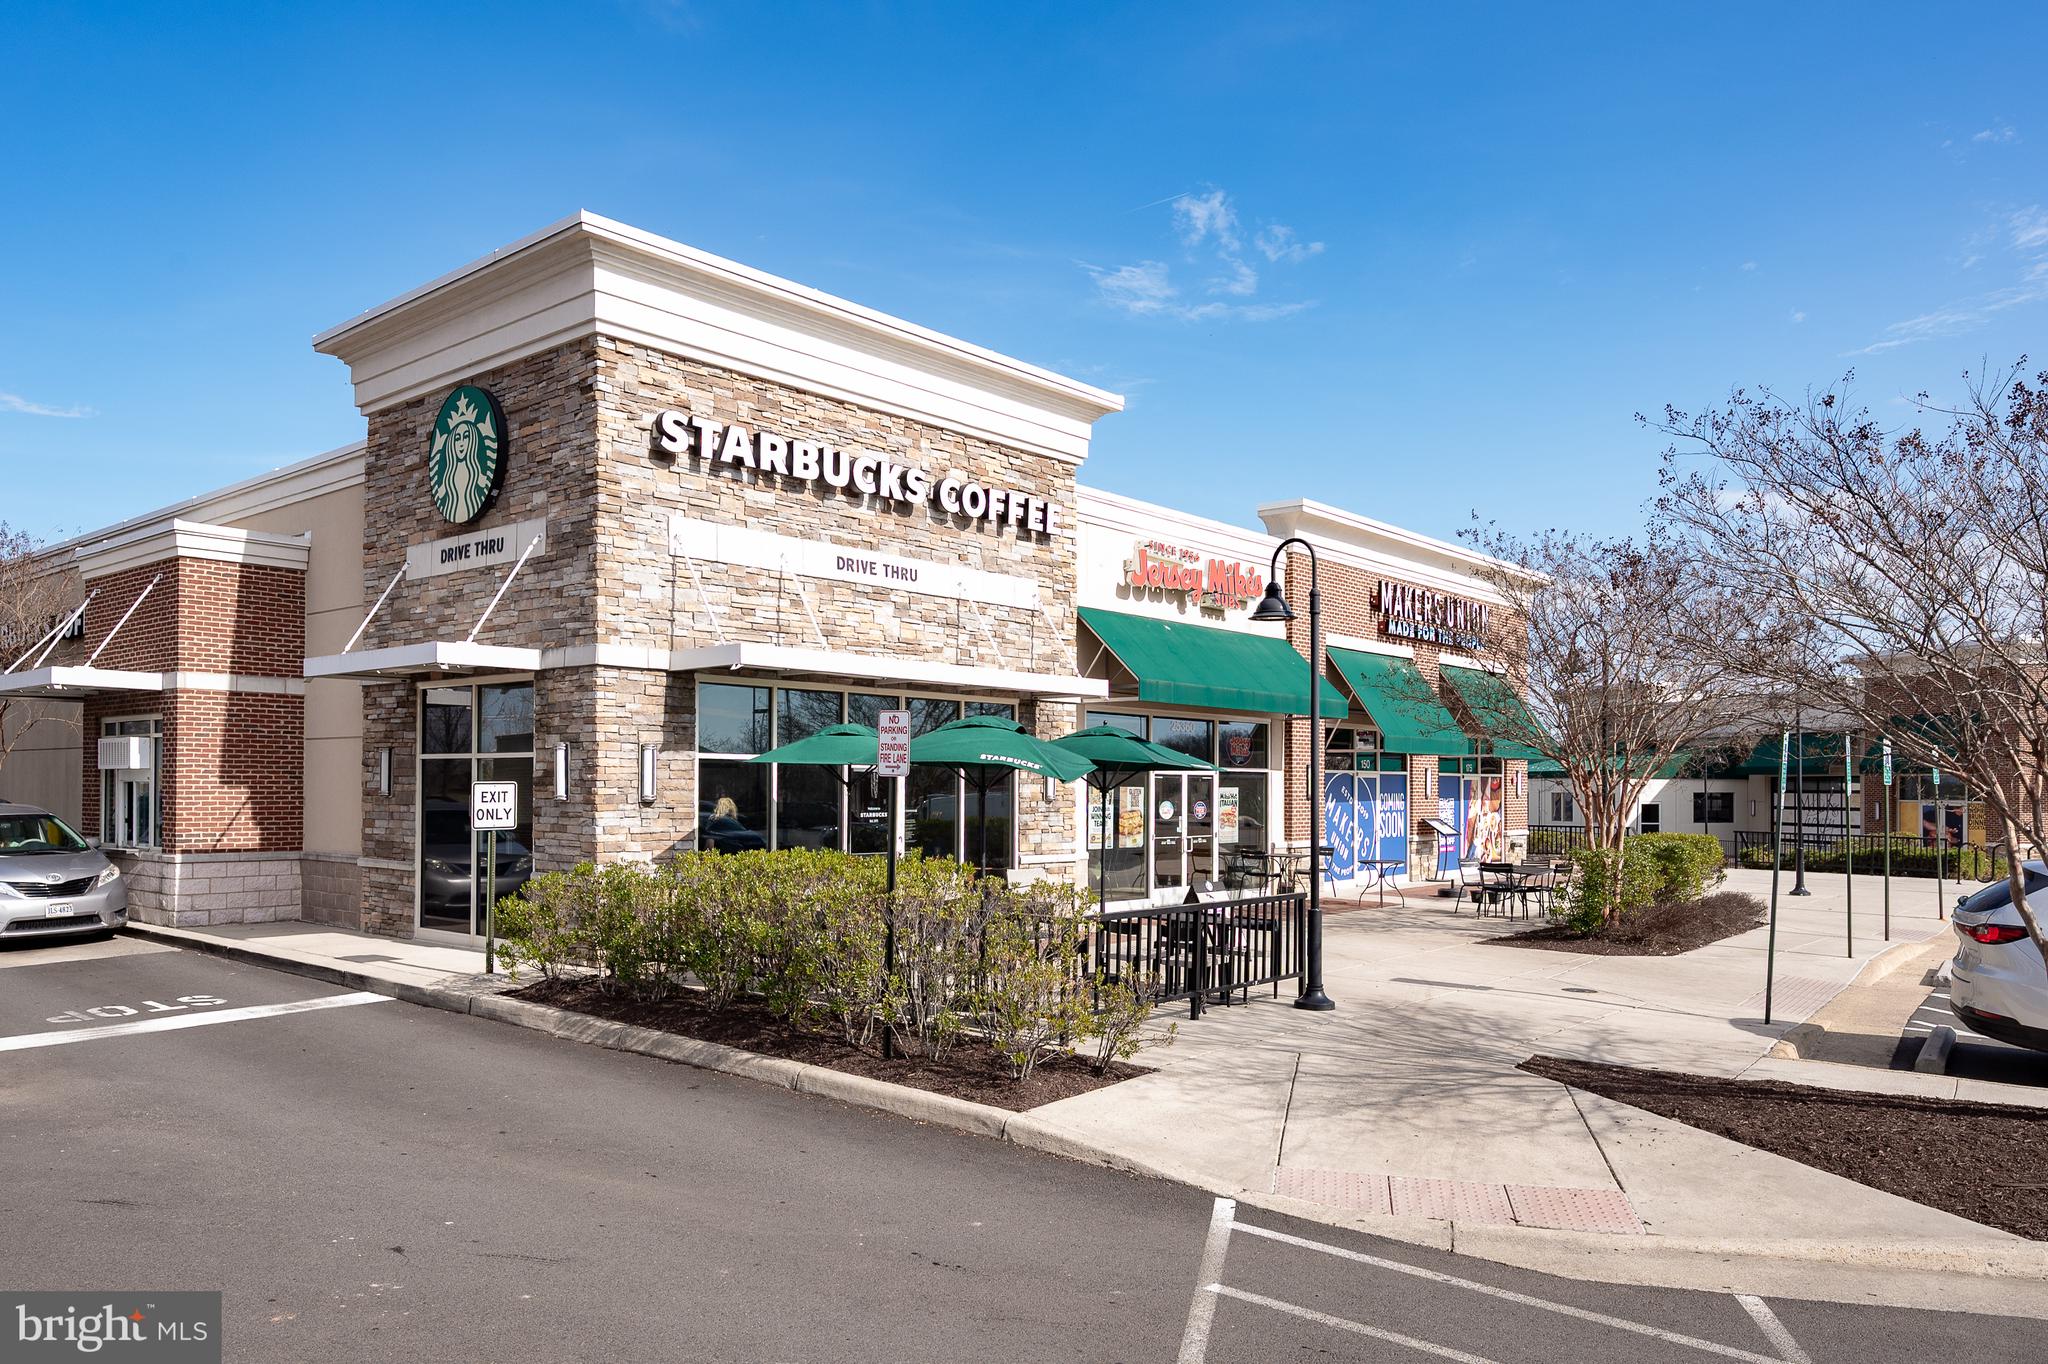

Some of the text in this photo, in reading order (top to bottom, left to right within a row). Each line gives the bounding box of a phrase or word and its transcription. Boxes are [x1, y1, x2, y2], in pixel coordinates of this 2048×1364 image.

[657, 410, 1062, 534] STARBUCKS COFFEE
[441, 537, 504, 564] DRIVE THRU
[1149, 540, 1176, 556] SINCE
[836, 555, 918, 582] DRIVE THRU
[1131, 549, 1263, 603] Jersey Mike's
[1215, 593, 1241, 609] SUBS
[1381, 580, 1489, 634] MAKERS UNION
[1388, 618, 1415, 638] MADE
[1417, 624, 1436, 642] FOR
[1438, 628, 1454, 646] THE
[880, 726, 908, 735] PARKING
[888, 716, 900, 725] NO
[880, 743, 907, 752] STANDING
[880, 754, 907, 763] FIRE LANE
[979, 754, 1041, 770] STARBUCKS
[481, 791, 508, 803] EXIT
[1379, 793, 1405, 811] COMING
[476, 808, 512, 821] ONLY
[1325, 793, 1369, 858] MAKERS
[1379, 811, 1405, 838] SOON
[1330, 831, 1349, 861] UNION
[46, 994, 228, 1024] STOP
